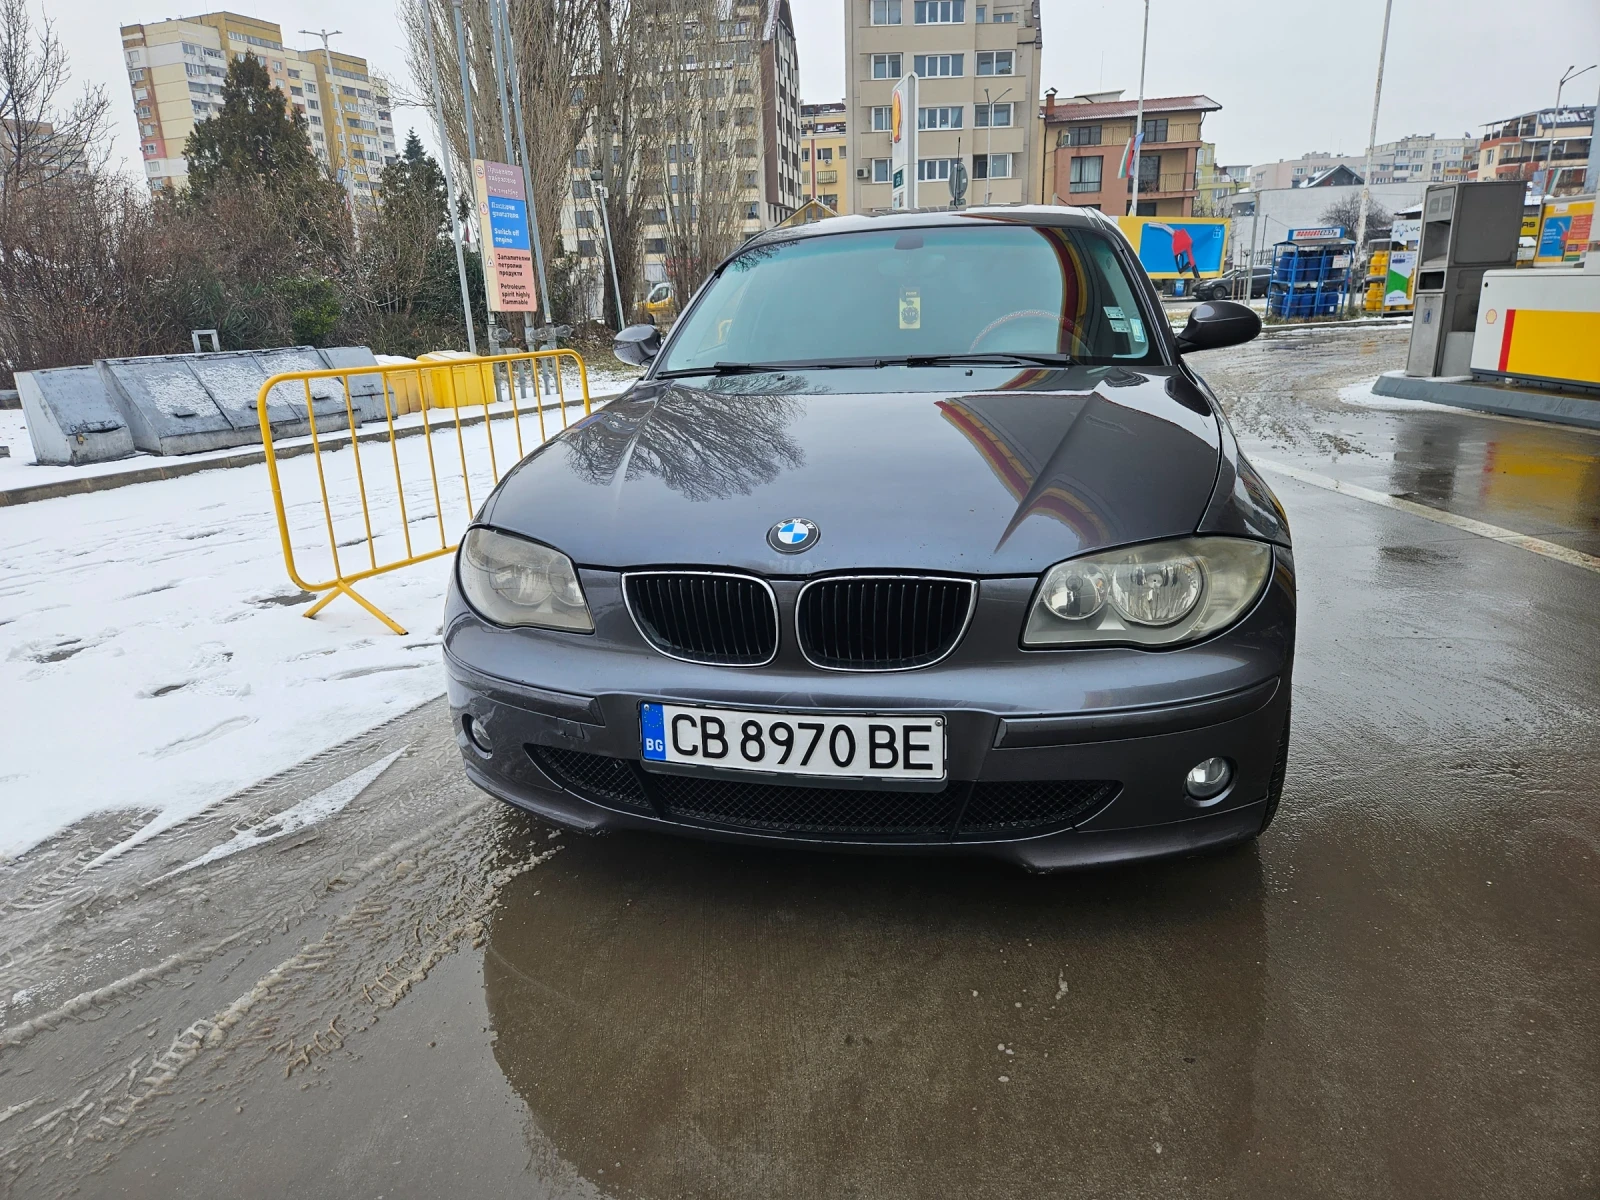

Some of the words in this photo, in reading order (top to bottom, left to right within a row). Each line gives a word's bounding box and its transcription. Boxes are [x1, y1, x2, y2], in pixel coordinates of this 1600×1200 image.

[494, 227, 512, 236] Switch
[512, 229, 520, 237] off
[495, 236, 513, 245] engine
[497, 253, 531, 262] Запалителни
[499, 270, 523, 278] продукти
[500, 282, 527, 290] Petroleum
[502, 291, 515, 299] spirit
[516, 291, 531, 300] highly
[502, 298, 529, 306] flammable
[645, 738, 664, 752] BG
[671, 713, 729, 759] CB
[740, 719, 856, 768] 8970
[868, 724, 933, 770] BE
